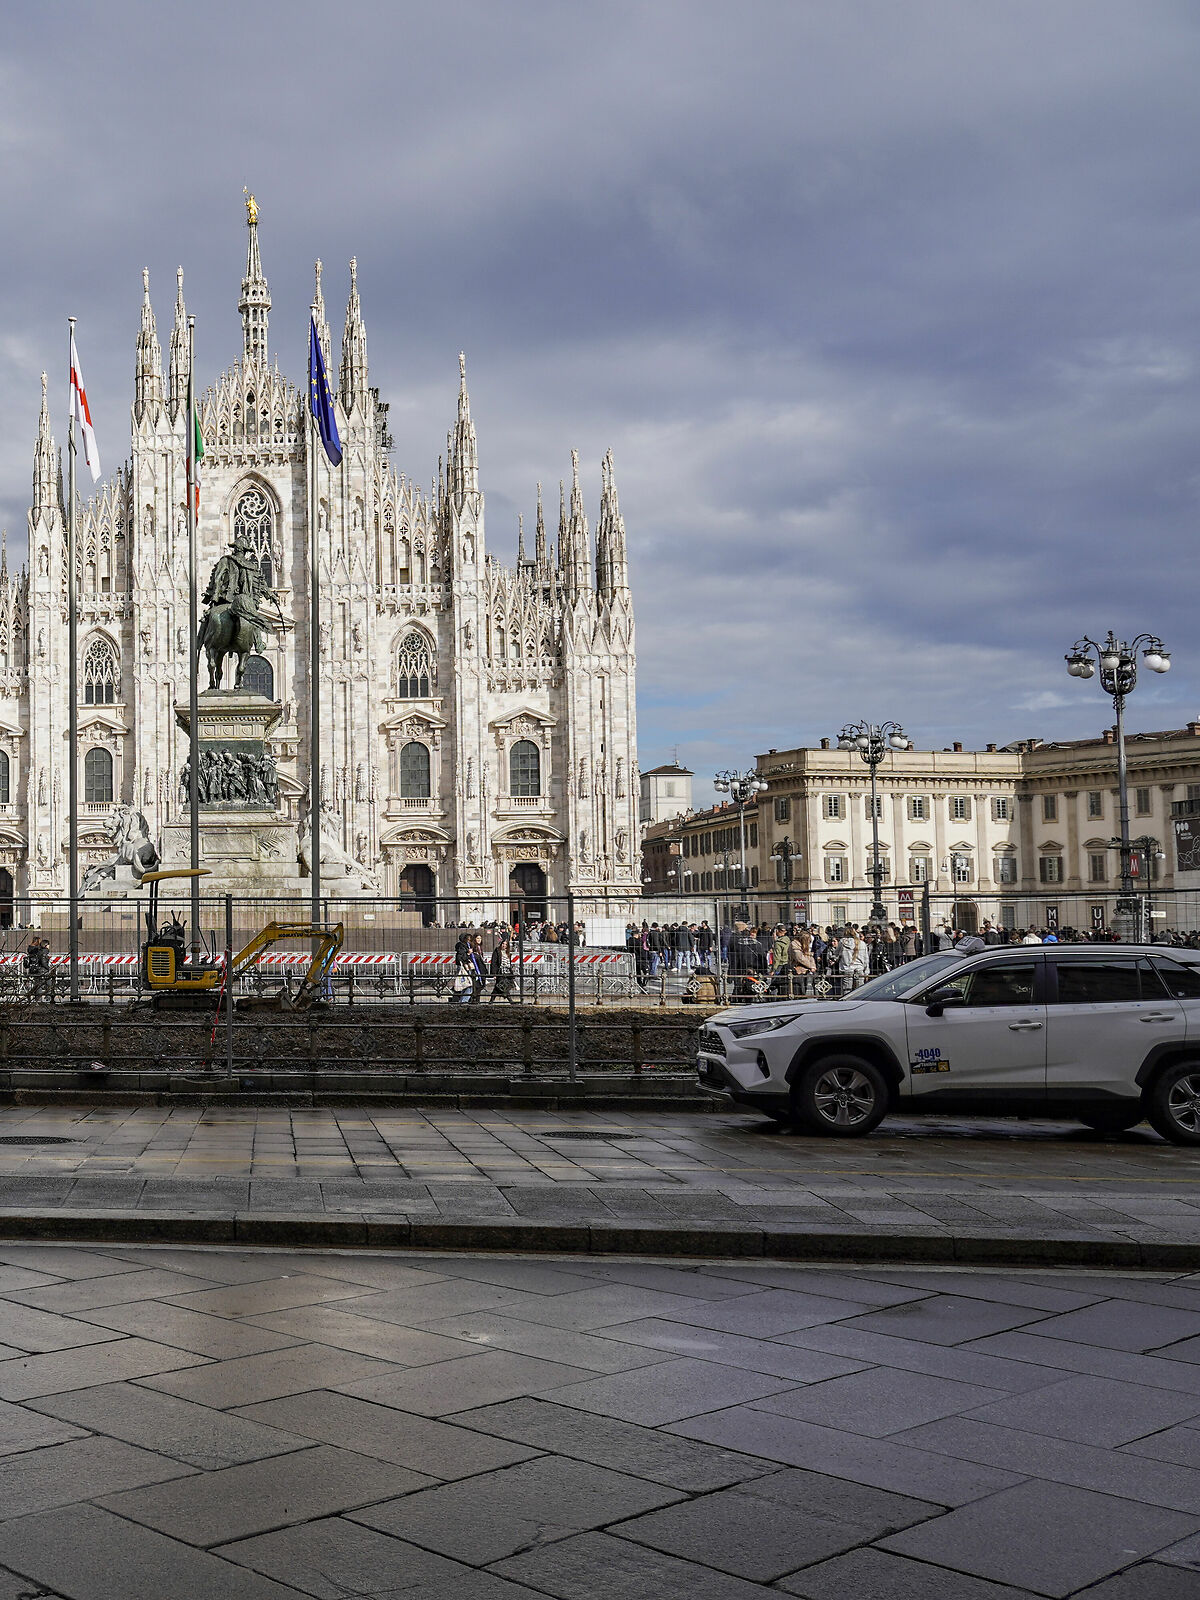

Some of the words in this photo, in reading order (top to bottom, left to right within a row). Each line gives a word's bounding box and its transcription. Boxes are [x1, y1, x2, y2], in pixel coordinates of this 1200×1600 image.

[1130, 859, 1138, 873] M
[900, 893, 911, 901] M
[1048, 909, 1057, 919] M
[1094, 908, 1102, 919] U
[918, 1047, 941, 1060] 4040
